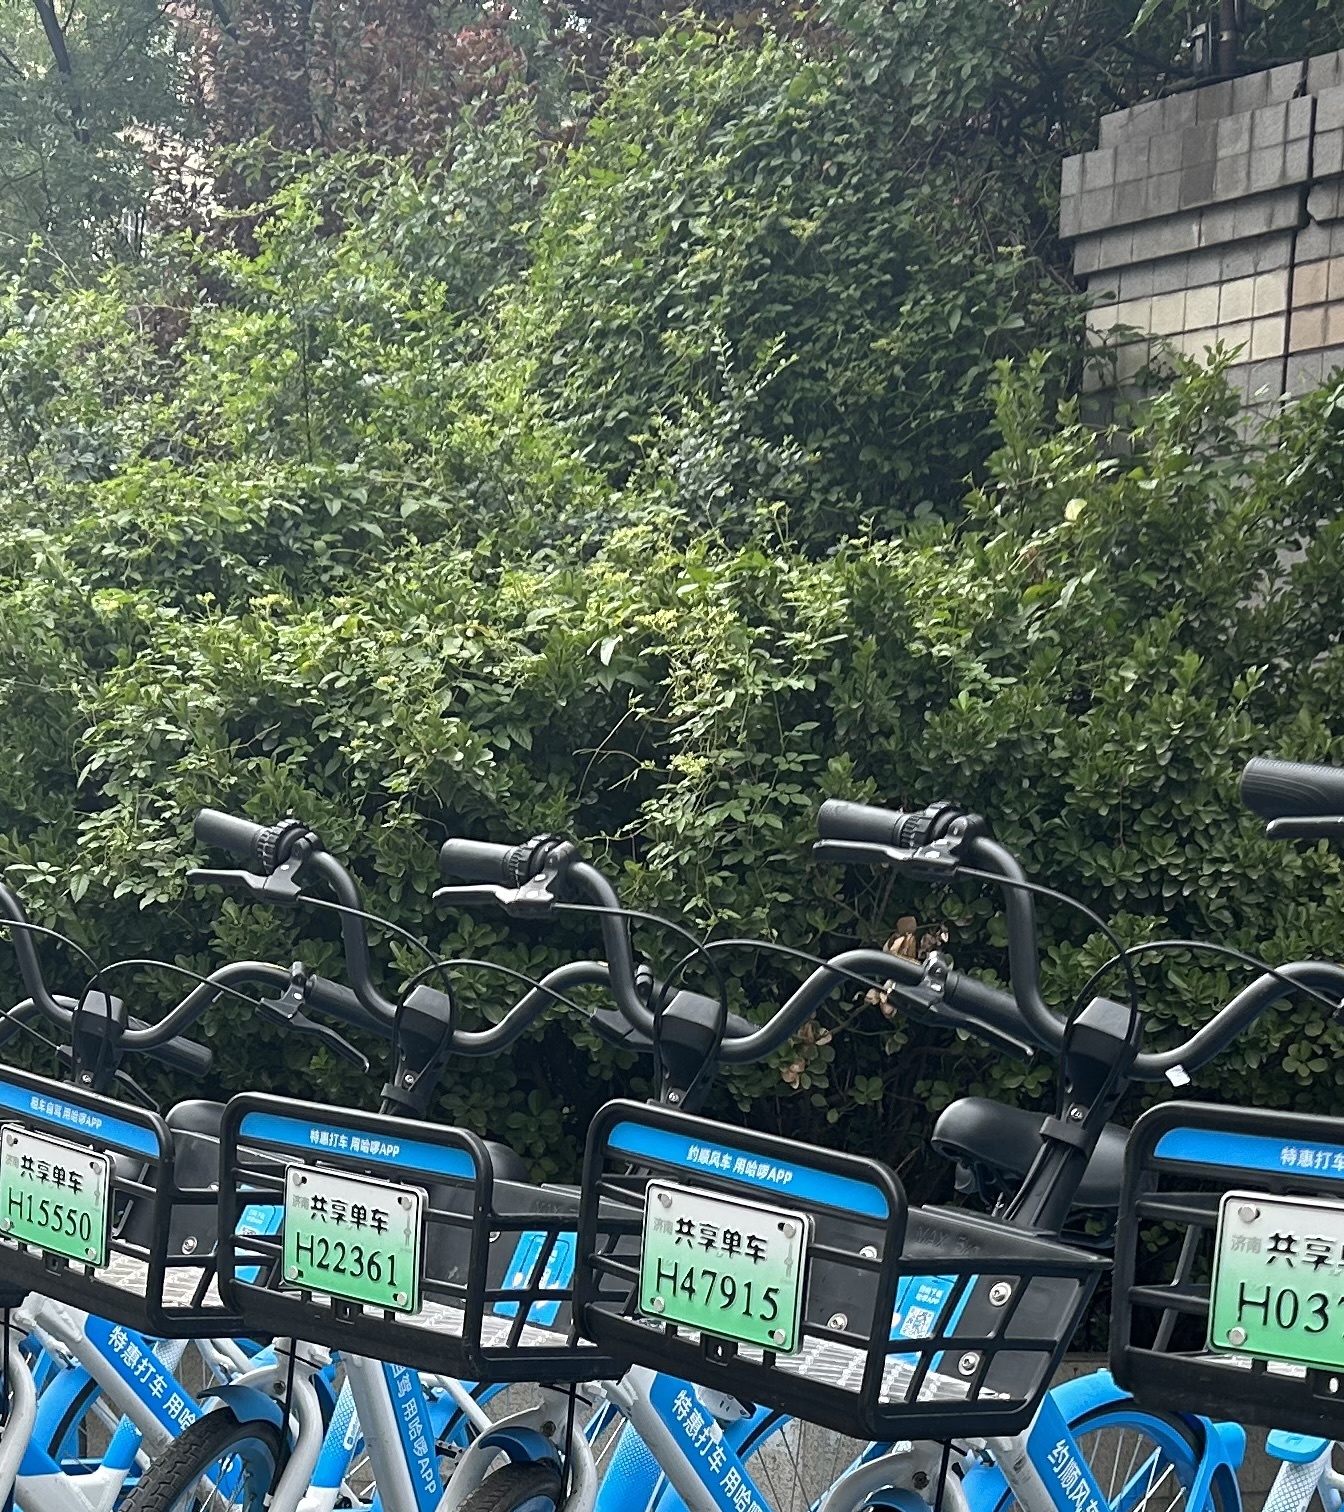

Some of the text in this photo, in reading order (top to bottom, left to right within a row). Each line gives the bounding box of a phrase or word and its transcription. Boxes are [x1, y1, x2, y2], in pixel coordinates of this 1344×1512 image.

[309, 1129, 348, 1149] 特惠打车
[687, 1144, 793, 1185] 约顺风车 用哈啰APP
[20, 1154, 84, 1194] 共享单车
[8, 1187, 91, 1241] H15550
[311, 1194, 389, 1234] 共享单车
[674, 1216, 769, 1264] 共享单车
[295, 1231, 397, 1287] H22361
[656, 1257, 781, 1322] H47915
[108, 1325, 168, 1399] 特惠打车
[401, 1396, 437, 1495] 用哈啰APP
[671, 1389, 728, 1474] 特惠打车
